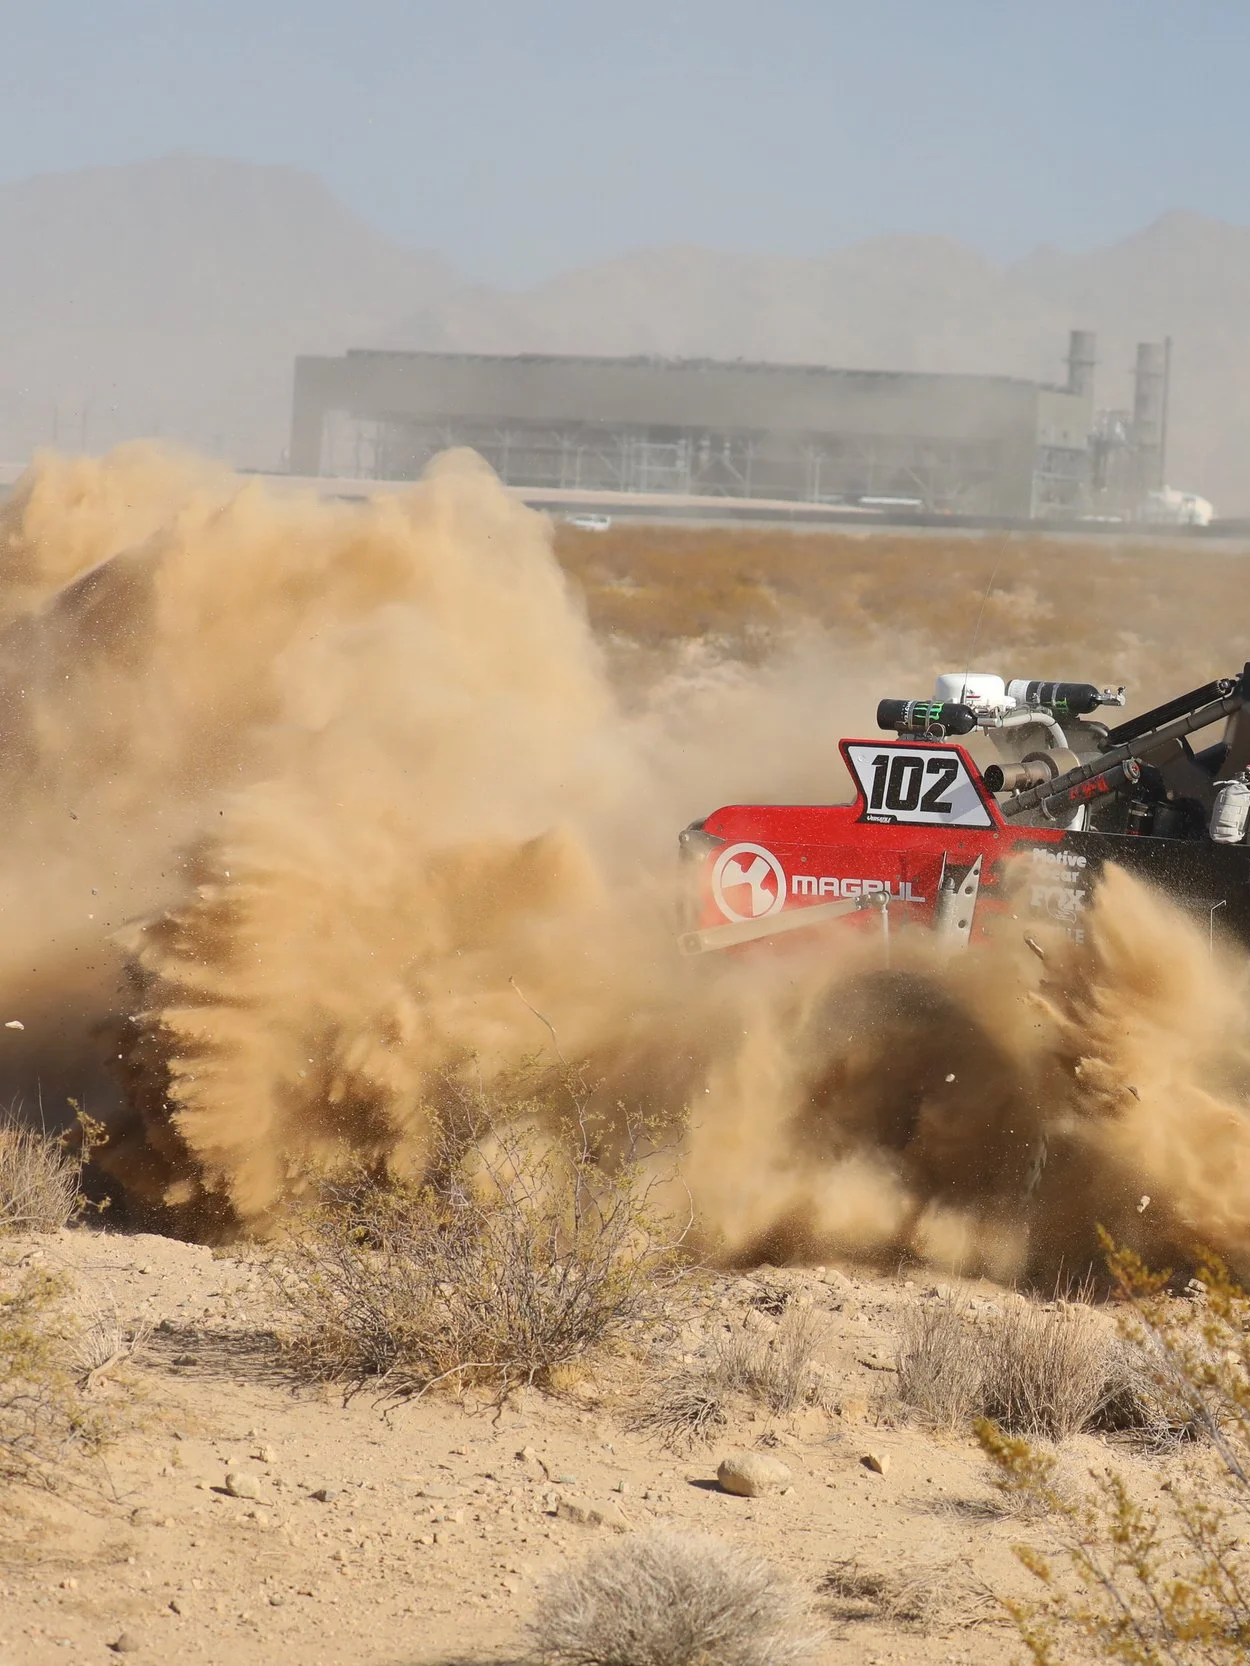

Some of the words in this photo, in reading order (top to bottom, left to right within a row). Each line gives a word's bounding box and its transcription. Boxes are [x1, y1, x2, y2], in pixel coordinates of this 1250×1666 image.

[870, 754, 959, 813] 102
[1033, 847, 1087, 868] Motive
[791, 874, 926, 903] MAGPUL
